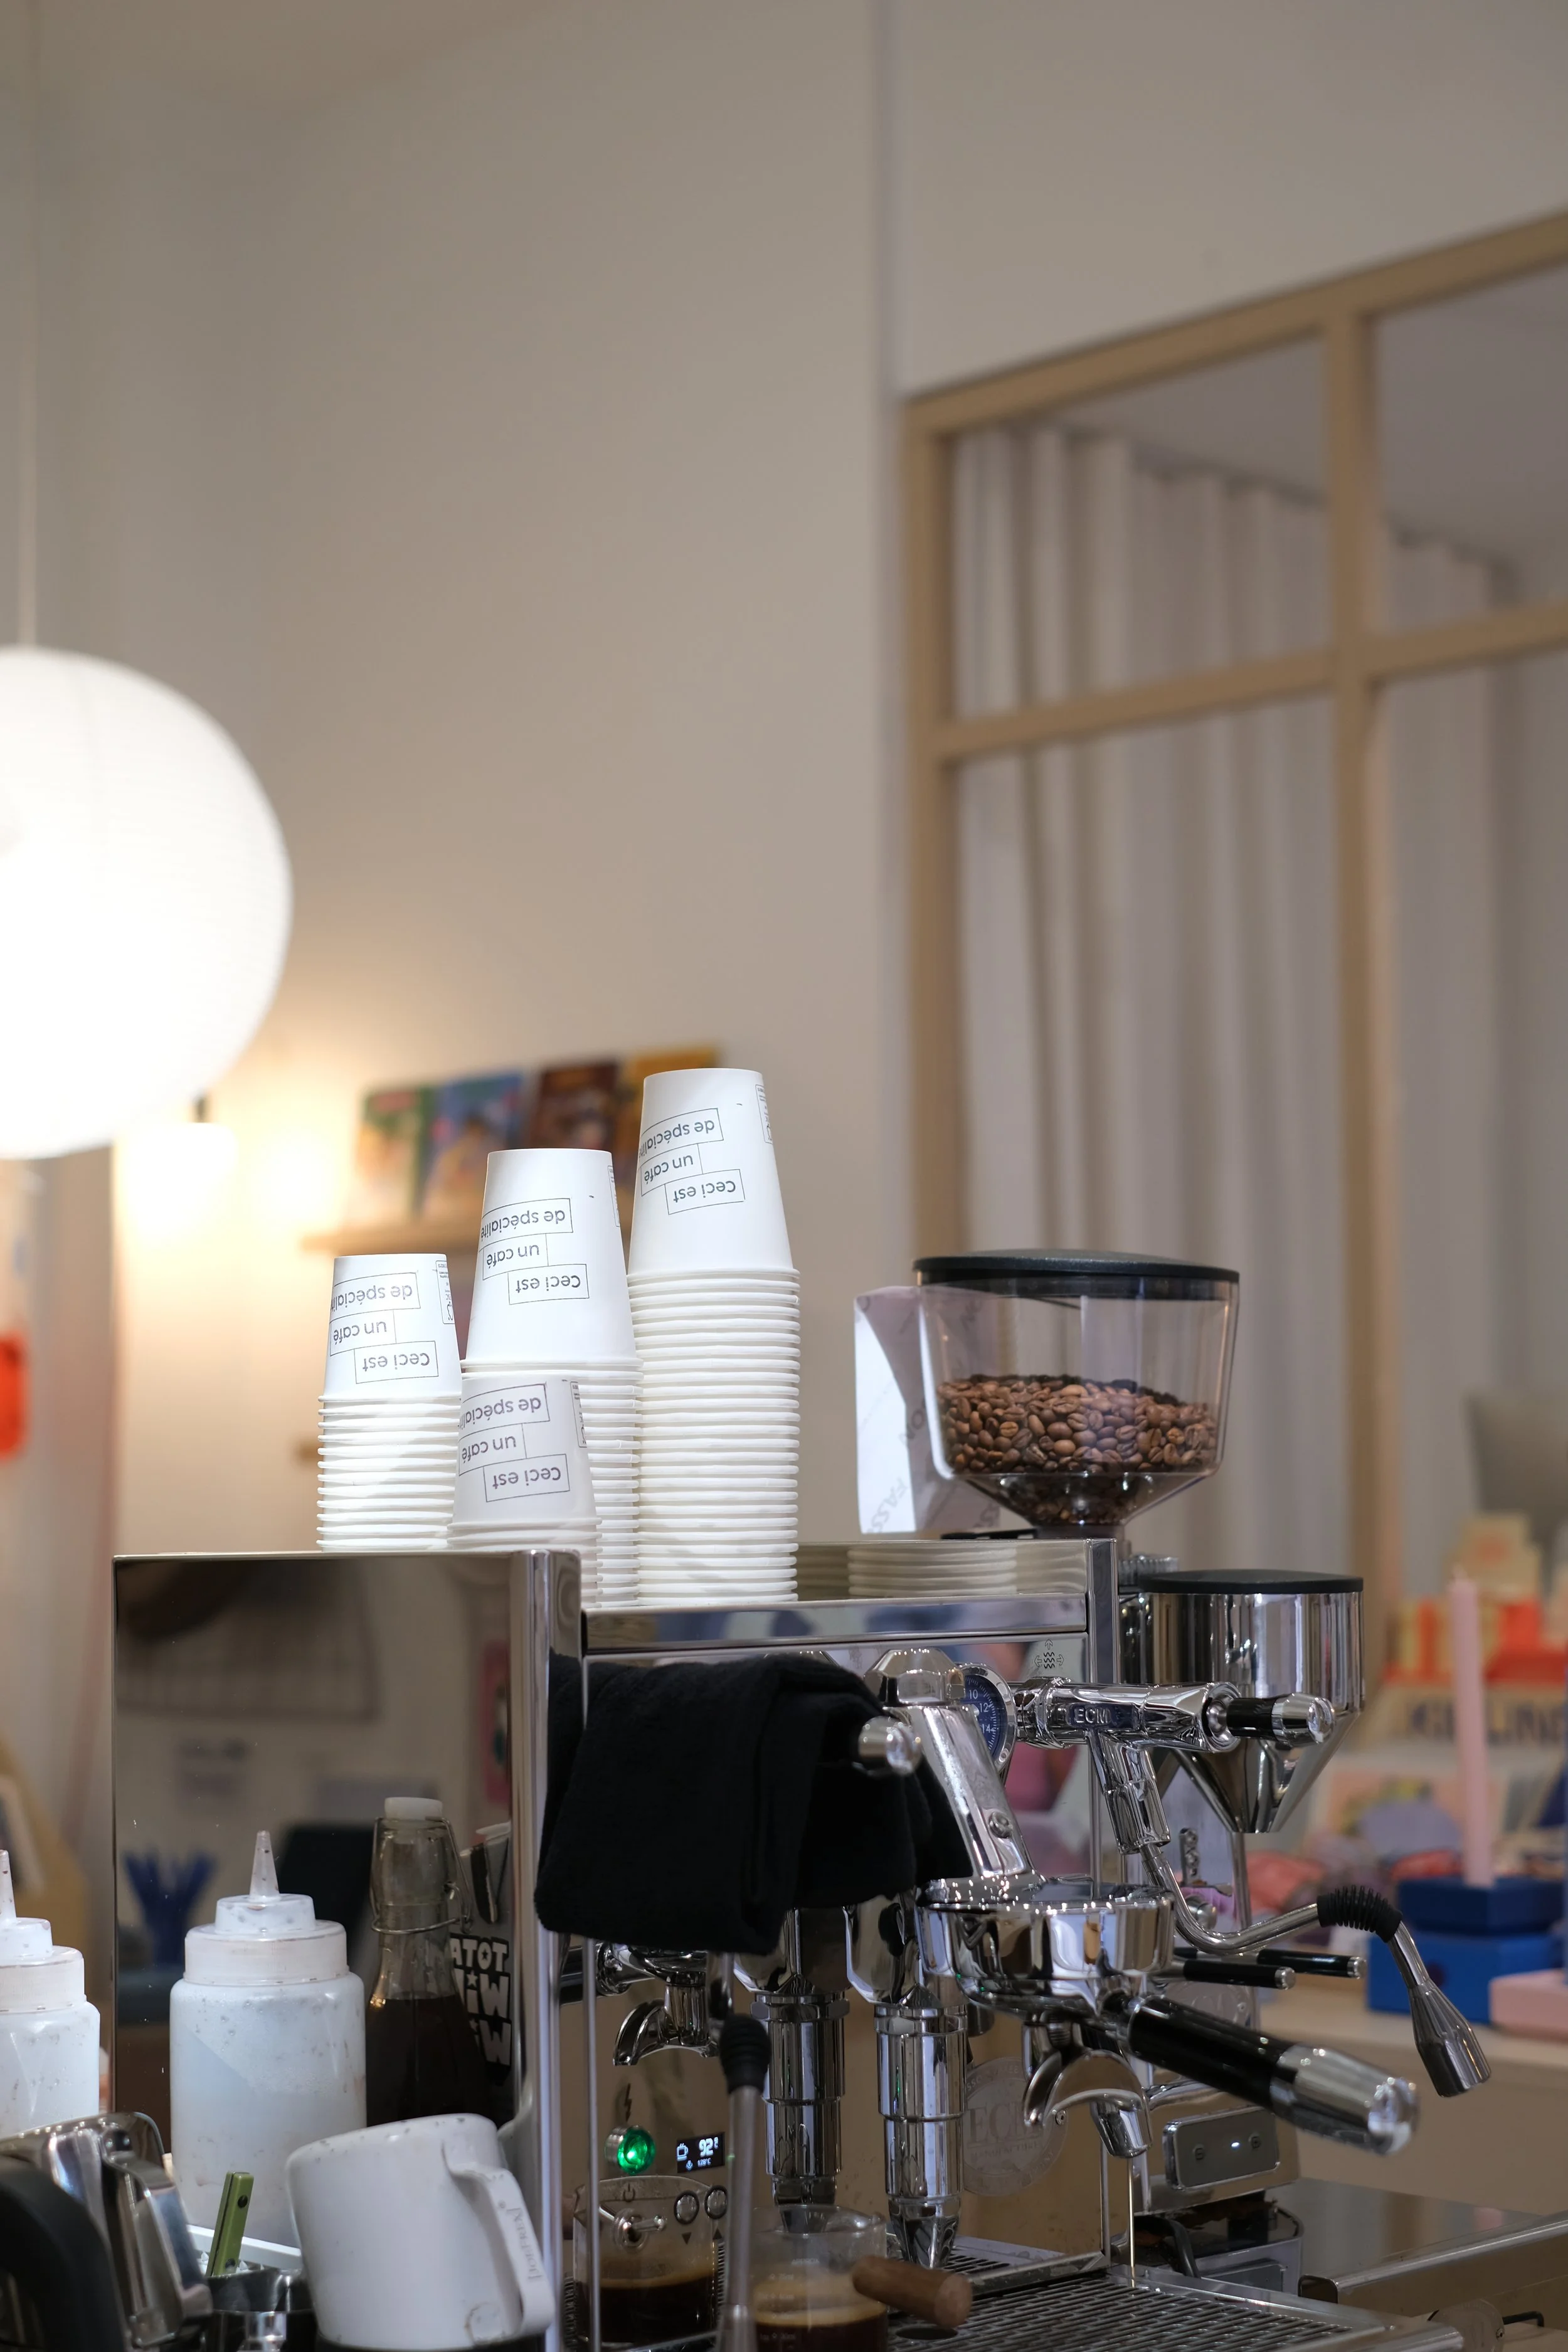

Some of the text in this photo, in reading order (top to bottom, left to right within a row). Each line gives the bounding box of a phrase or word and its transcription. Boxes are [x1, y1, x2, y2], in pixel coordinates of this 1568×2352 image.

[694, 1120, 714, 1133] de
[644, 1155, 693, 1184] un café
[674, 1187, 696, 1202] est
[481, 1210, 565, 1241] de spécialité
[487, 1245, 539, 1269] un café
[516, 1278, 539, 1293] est
[331, 1285, 412, 1311] de spécialit
[334, 1322, 386, 1345] un café
[363, 1353, 388, 1372] est
[519, 1397, 541, 1412] de
[462, 1436, 516, 1463] un café
[492, 1472, 518, 1489] est
[867, 1476, 908, 1533] FASS
[969, 1690, 978, 1699] 10
[980, 1703, 988, 1712] 12
[1074, 1707, 1111, 1724] ECM
[982, 1724, 991, 1734] 14
